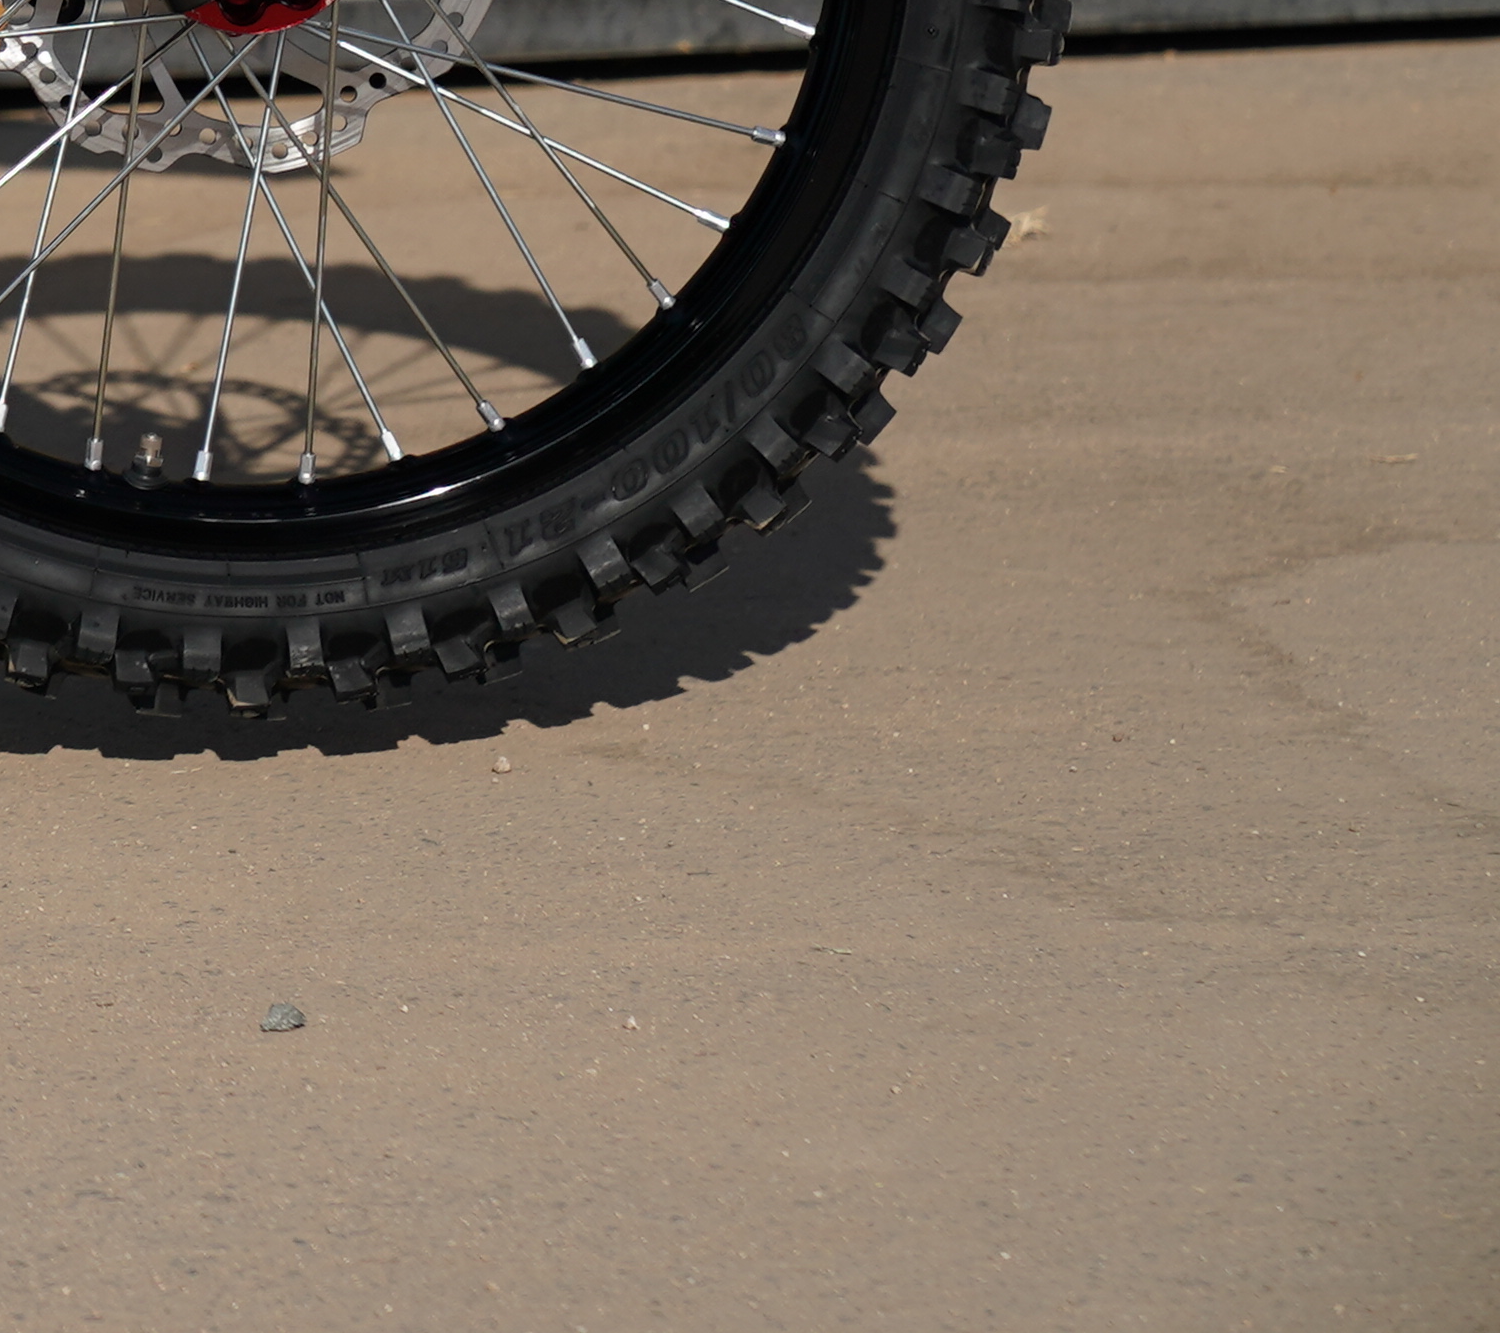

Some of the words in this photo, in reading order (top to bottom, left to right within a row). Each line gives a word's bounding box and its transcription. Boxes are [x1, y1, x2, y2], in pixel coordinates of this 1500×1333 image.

[132, 585, 195, 608] SERVICE
[203, 594, 269, 609] HIGHWAY
[276, 593, 307, 610] FOR
[315, 590, 345, 608] NOT
